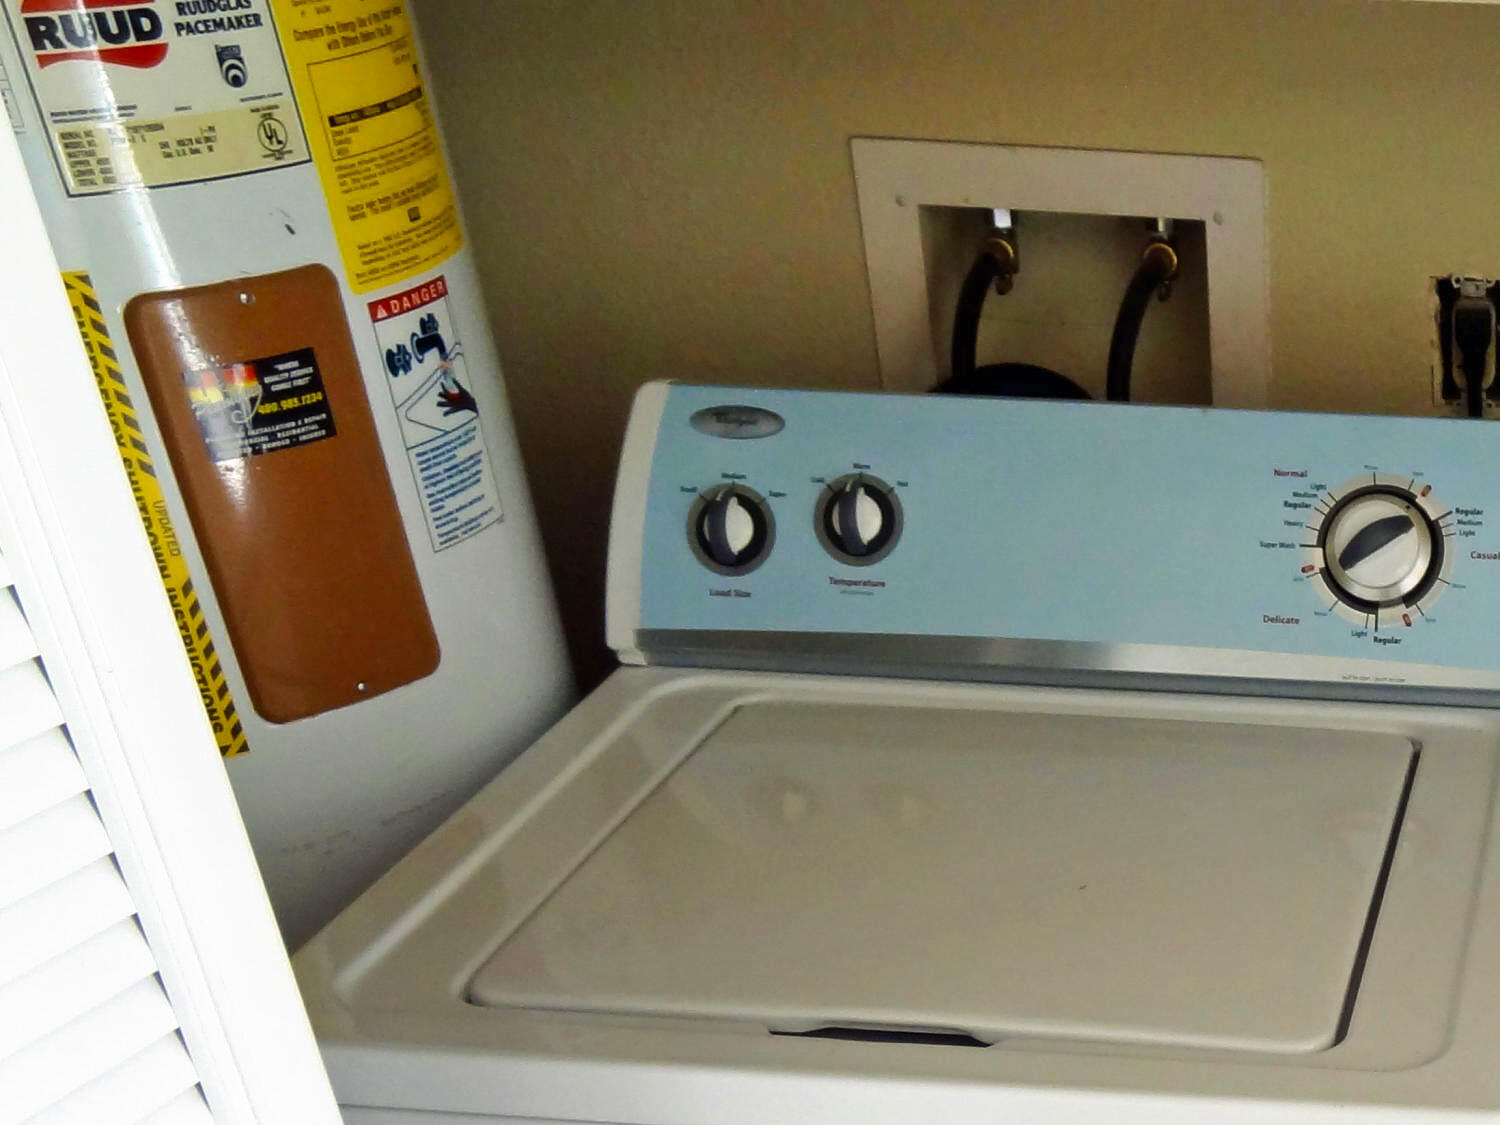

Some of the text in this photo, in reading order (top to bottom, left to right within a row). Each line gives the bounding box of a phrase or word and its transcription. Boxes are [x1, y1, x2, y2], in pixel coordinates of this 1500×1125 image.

[24, 8, 163, 51] RUUD
[174, 13, 263, 37] PACEMAKER
[390, 280, 445, 314] DANGER
[1273, 468, 1308, 479] Normal
[1283, 500, 1312, 510] Regular
[1455, 507, 1484, 517] Regular
[153, 500, 181, 558] UPDATED
[1459, 529, 1476, 538] Light
[1263, 614, 1301, 626] Delicate
[1351, 629, 1368, 639] Light
[1373, 635, 1402, 646] Regular
